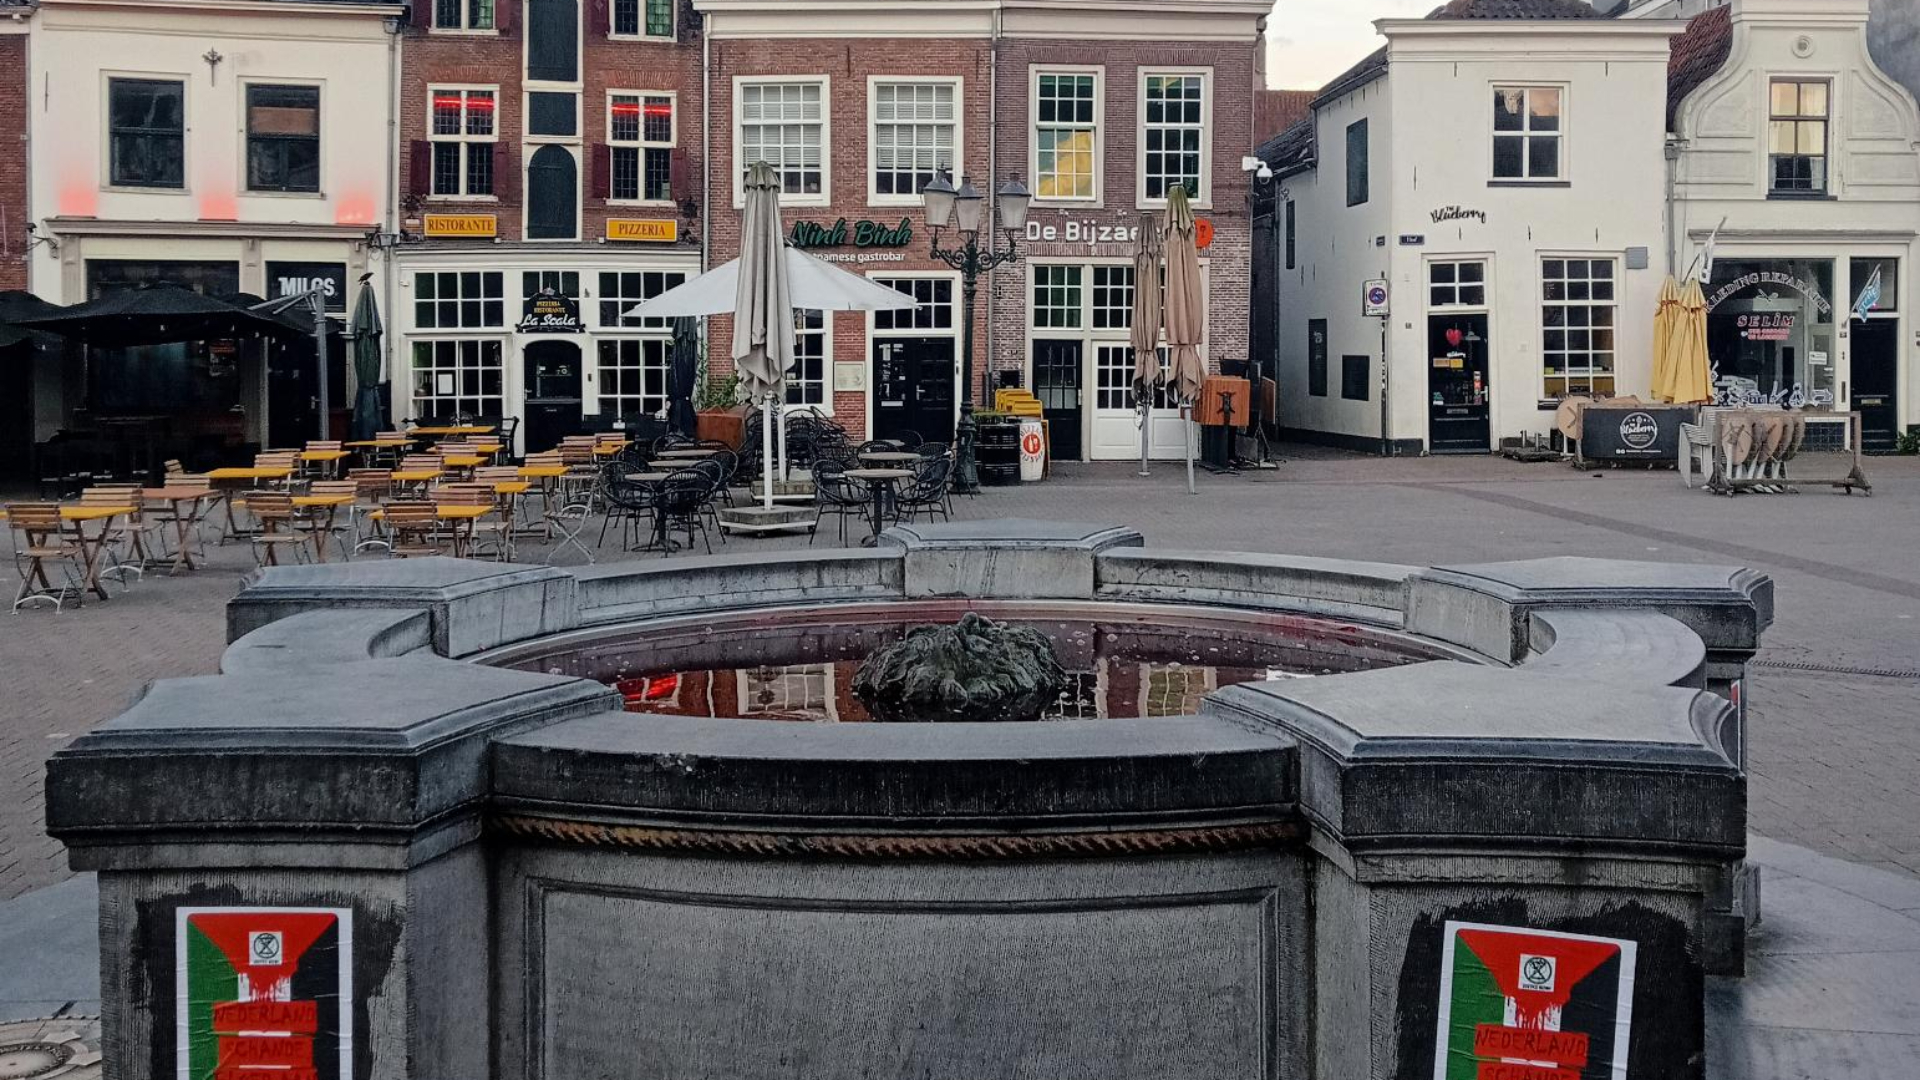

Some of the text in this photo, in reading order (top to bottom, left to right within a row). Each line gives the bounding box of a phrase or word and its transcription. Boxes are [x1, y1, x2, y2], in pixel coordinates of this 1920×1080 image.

[1430, 205, 1486, 224] Blueberry
[427, 218, 495, 232] RISTORANTE
[618, 222, 666, 236] PIZZERIA
[790, 217, 913, 248] Ninh Binh
[1026, 220, 1057, 241] De
[857, 251, 906, 263] gastrobar
[278, 276, 336, 297] MILOS
[1704, 272, 1759, 314] KLEDING
[520, 313, 576, 327] La Scala
[213, 1004, 316, 1024] NEDERLAND
[225, 1038, 306, 1059] SCHANDE
[1475, 1028, 1587, 1057] NEDERLAND
